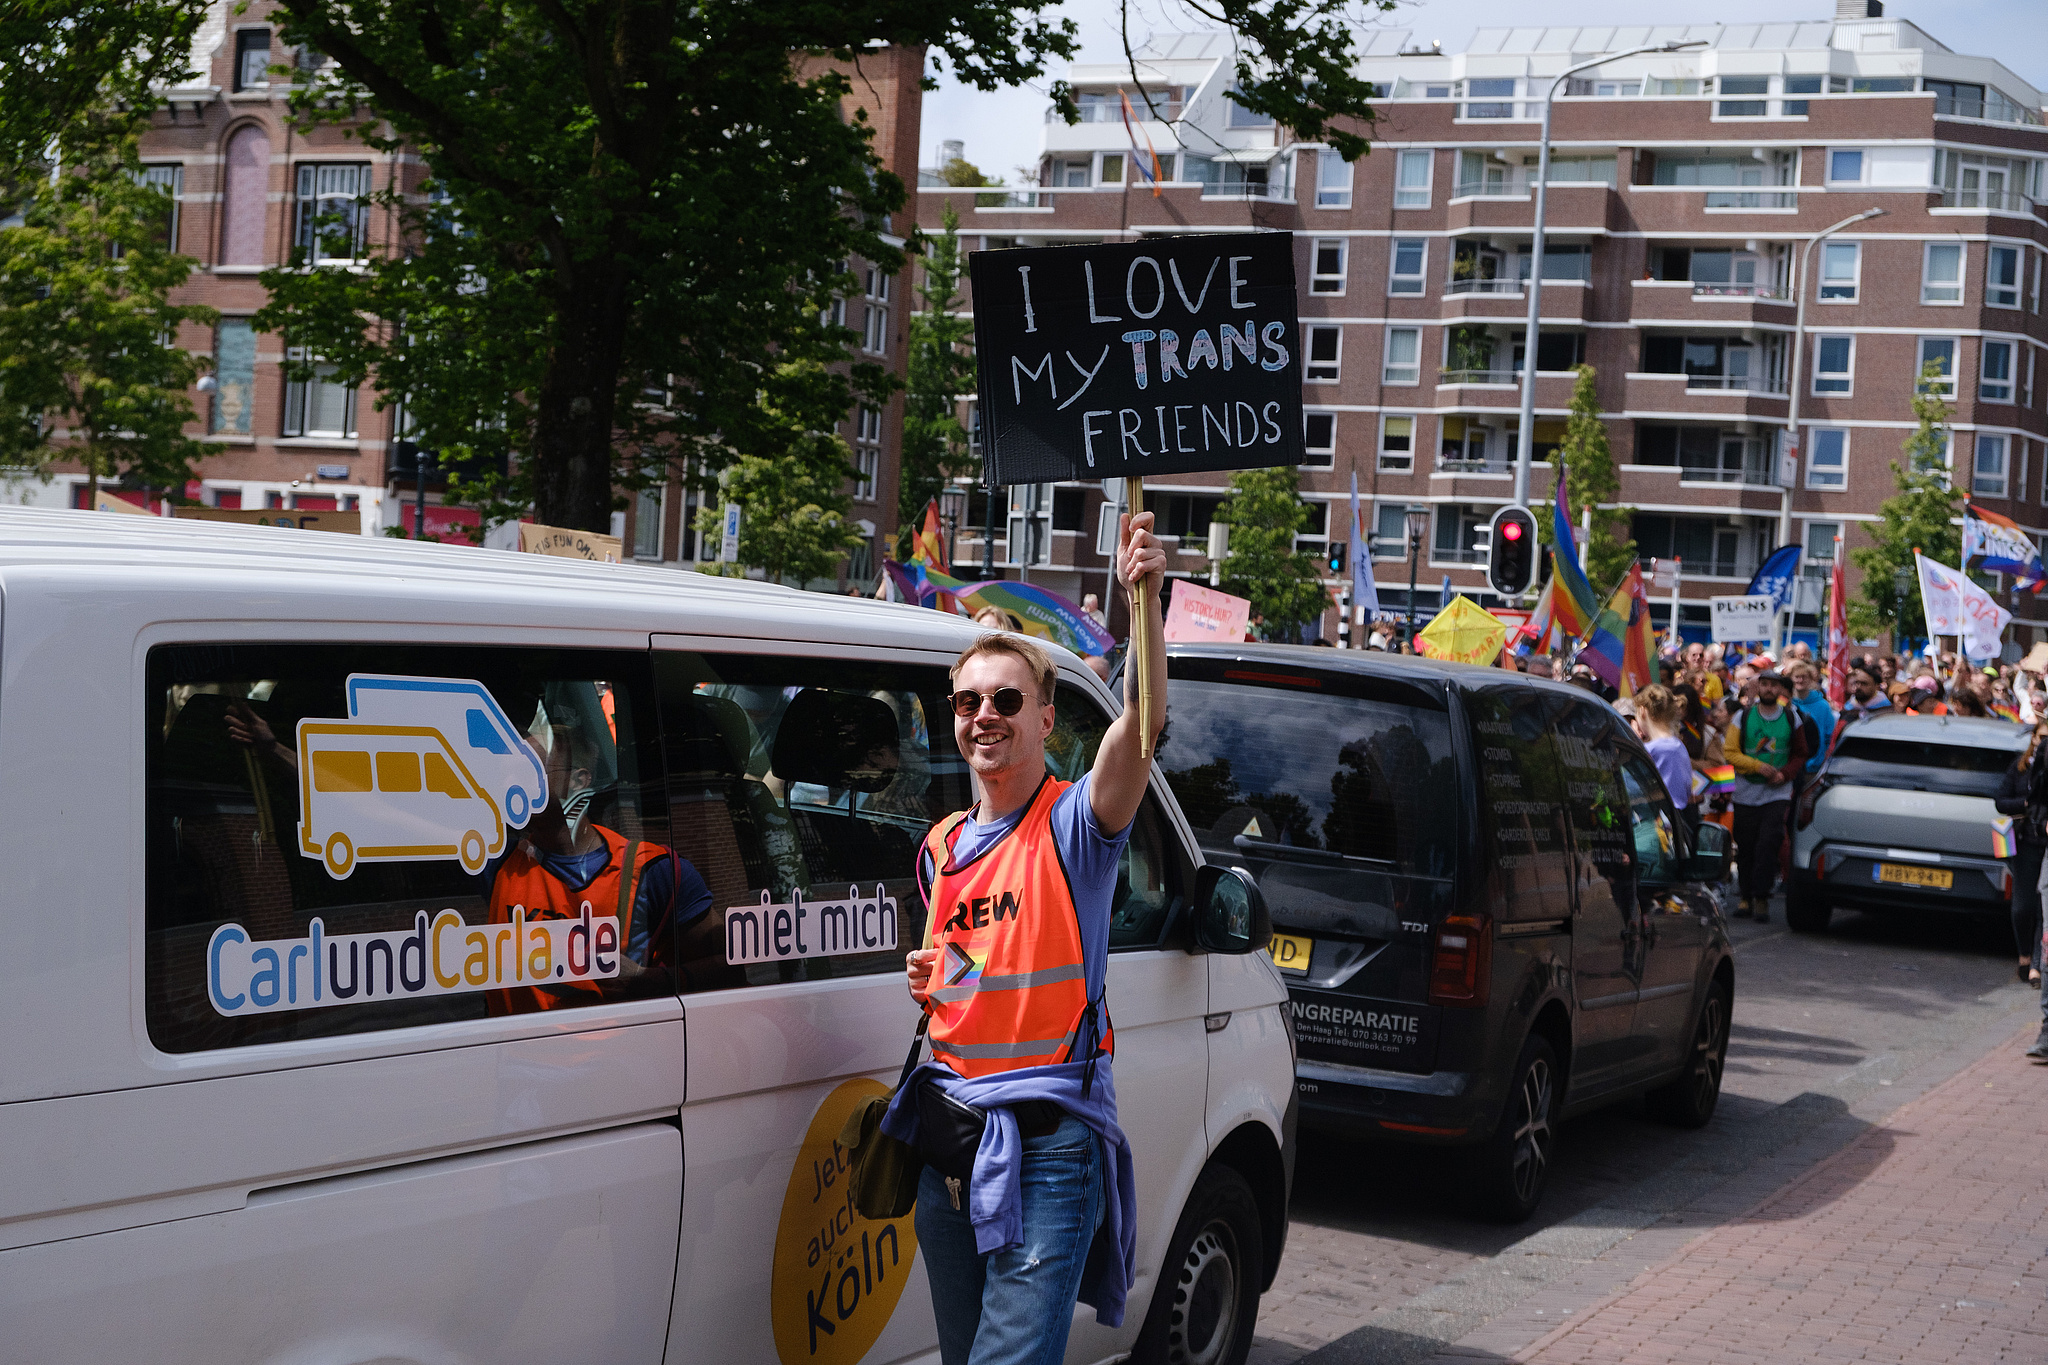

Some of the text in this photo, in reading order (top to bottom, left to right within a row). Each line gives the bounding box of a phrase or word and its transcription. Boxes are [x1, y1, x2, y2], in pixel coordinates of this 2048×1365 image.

[1017, 255, 1257, 333] I LOVE
[1011, 320, 1290, 411] MY TRANS
[1082, 401, 1282, 468] FRIENDS
[210, 905, 618, 1010] CarlundCarla.de
[728, 886, 896, 961] miet mich
[1401, 920, 1429, 933] TDI
[1297, 1022, 1312, 1032] Den
[1313, 1025, 1332, 1037] Haag
[1353, 1029, 1370, 1040] 070
[1372, 1032, 1389, 1042] 363
[1392, 1034, 1403, 1044] 70
[1406, 1036, 1417, 1045] 99
[807, 1222, 899, 1356] Köln
